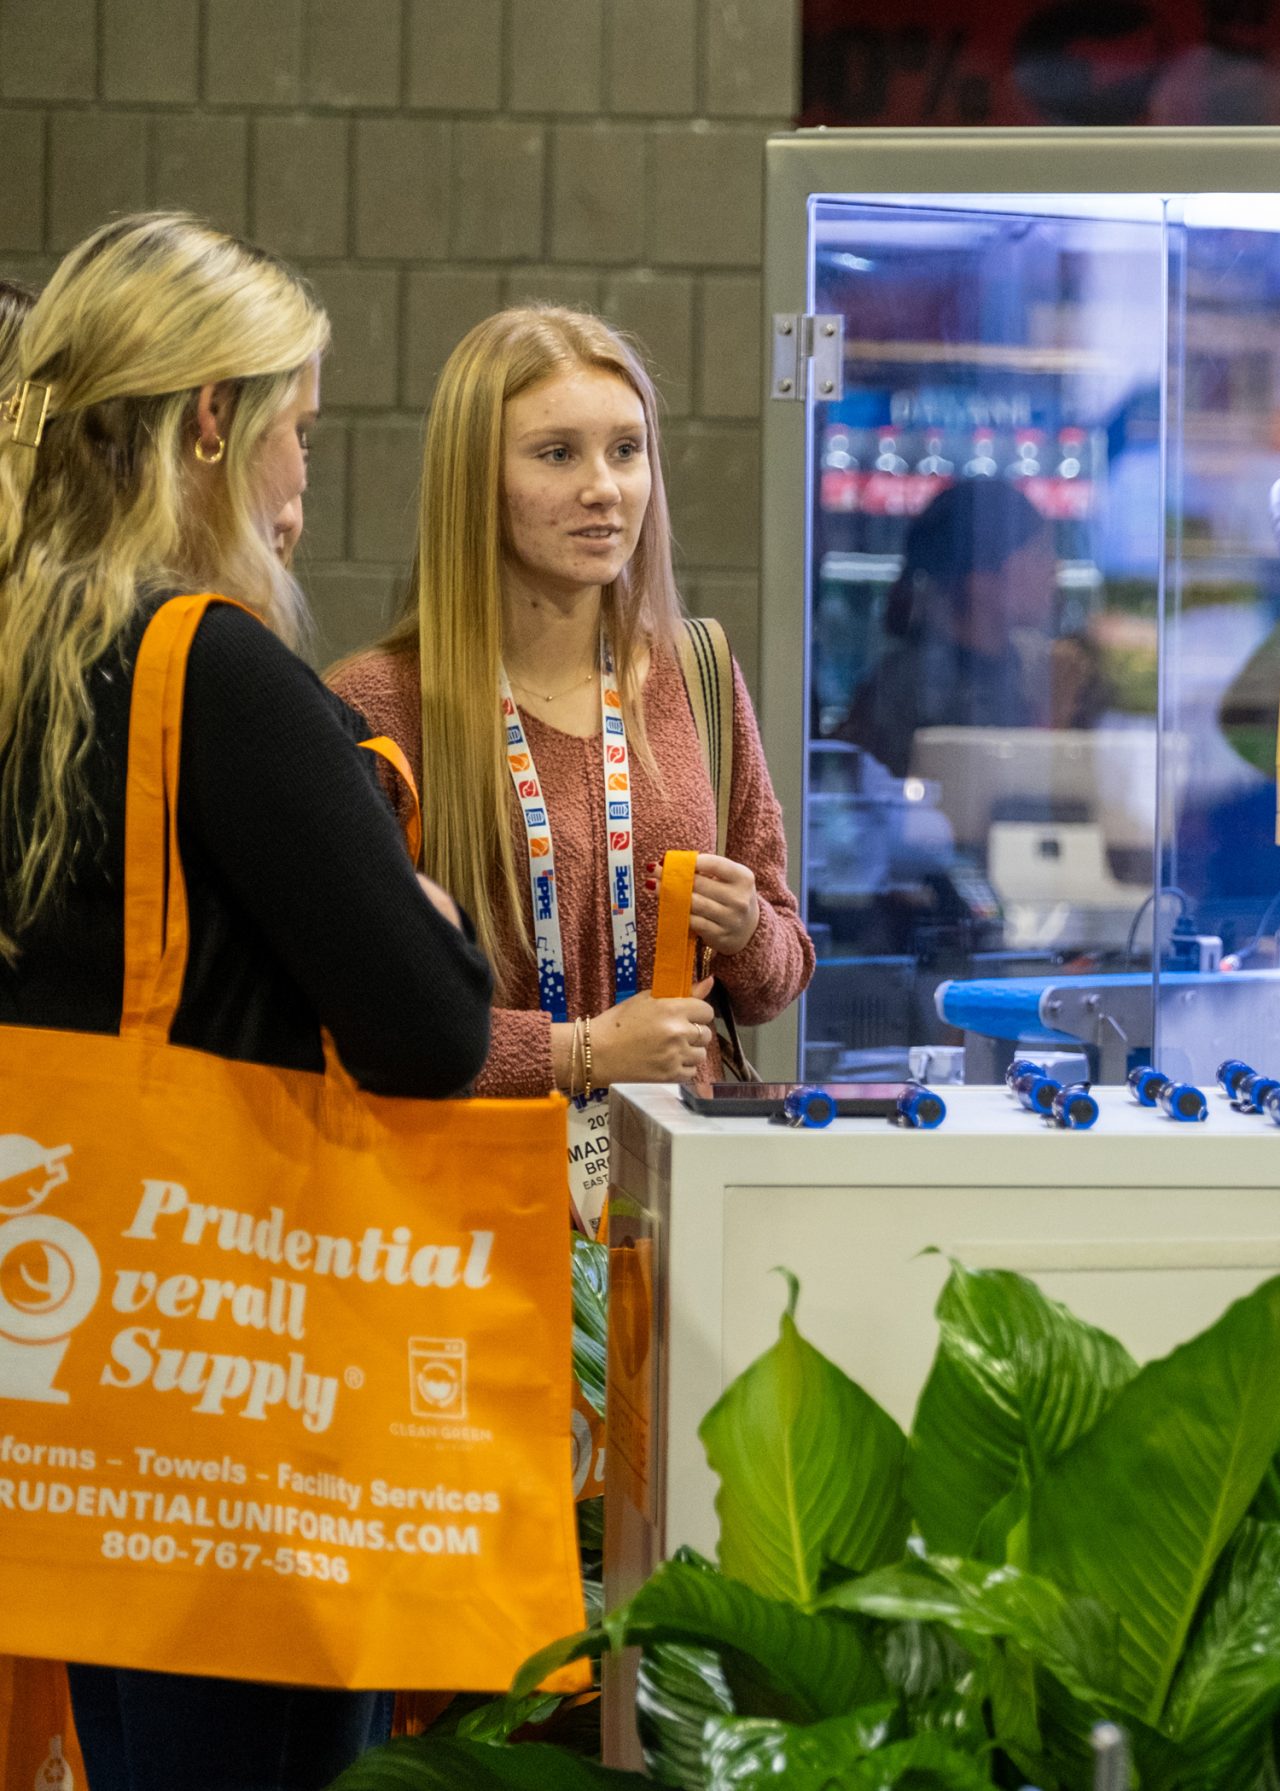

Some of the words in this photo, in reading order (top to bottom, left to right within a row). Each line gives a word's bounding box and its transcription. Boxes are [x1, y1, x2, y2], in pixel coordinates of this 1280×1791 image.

[537, 876, 552, 920] IPPE
[616, 866, 629, 909] IPPE
[585, 1155, 610, 1175] BR
[121, 1179, 494, 1289] Prudential
[134, 1447, 247, 1484] Towels
[277, 1463, 361, 1511] Facility
[370, 1480, 499, 1513] Services
[101, 1531, 350, 1584] 800-767-5536
